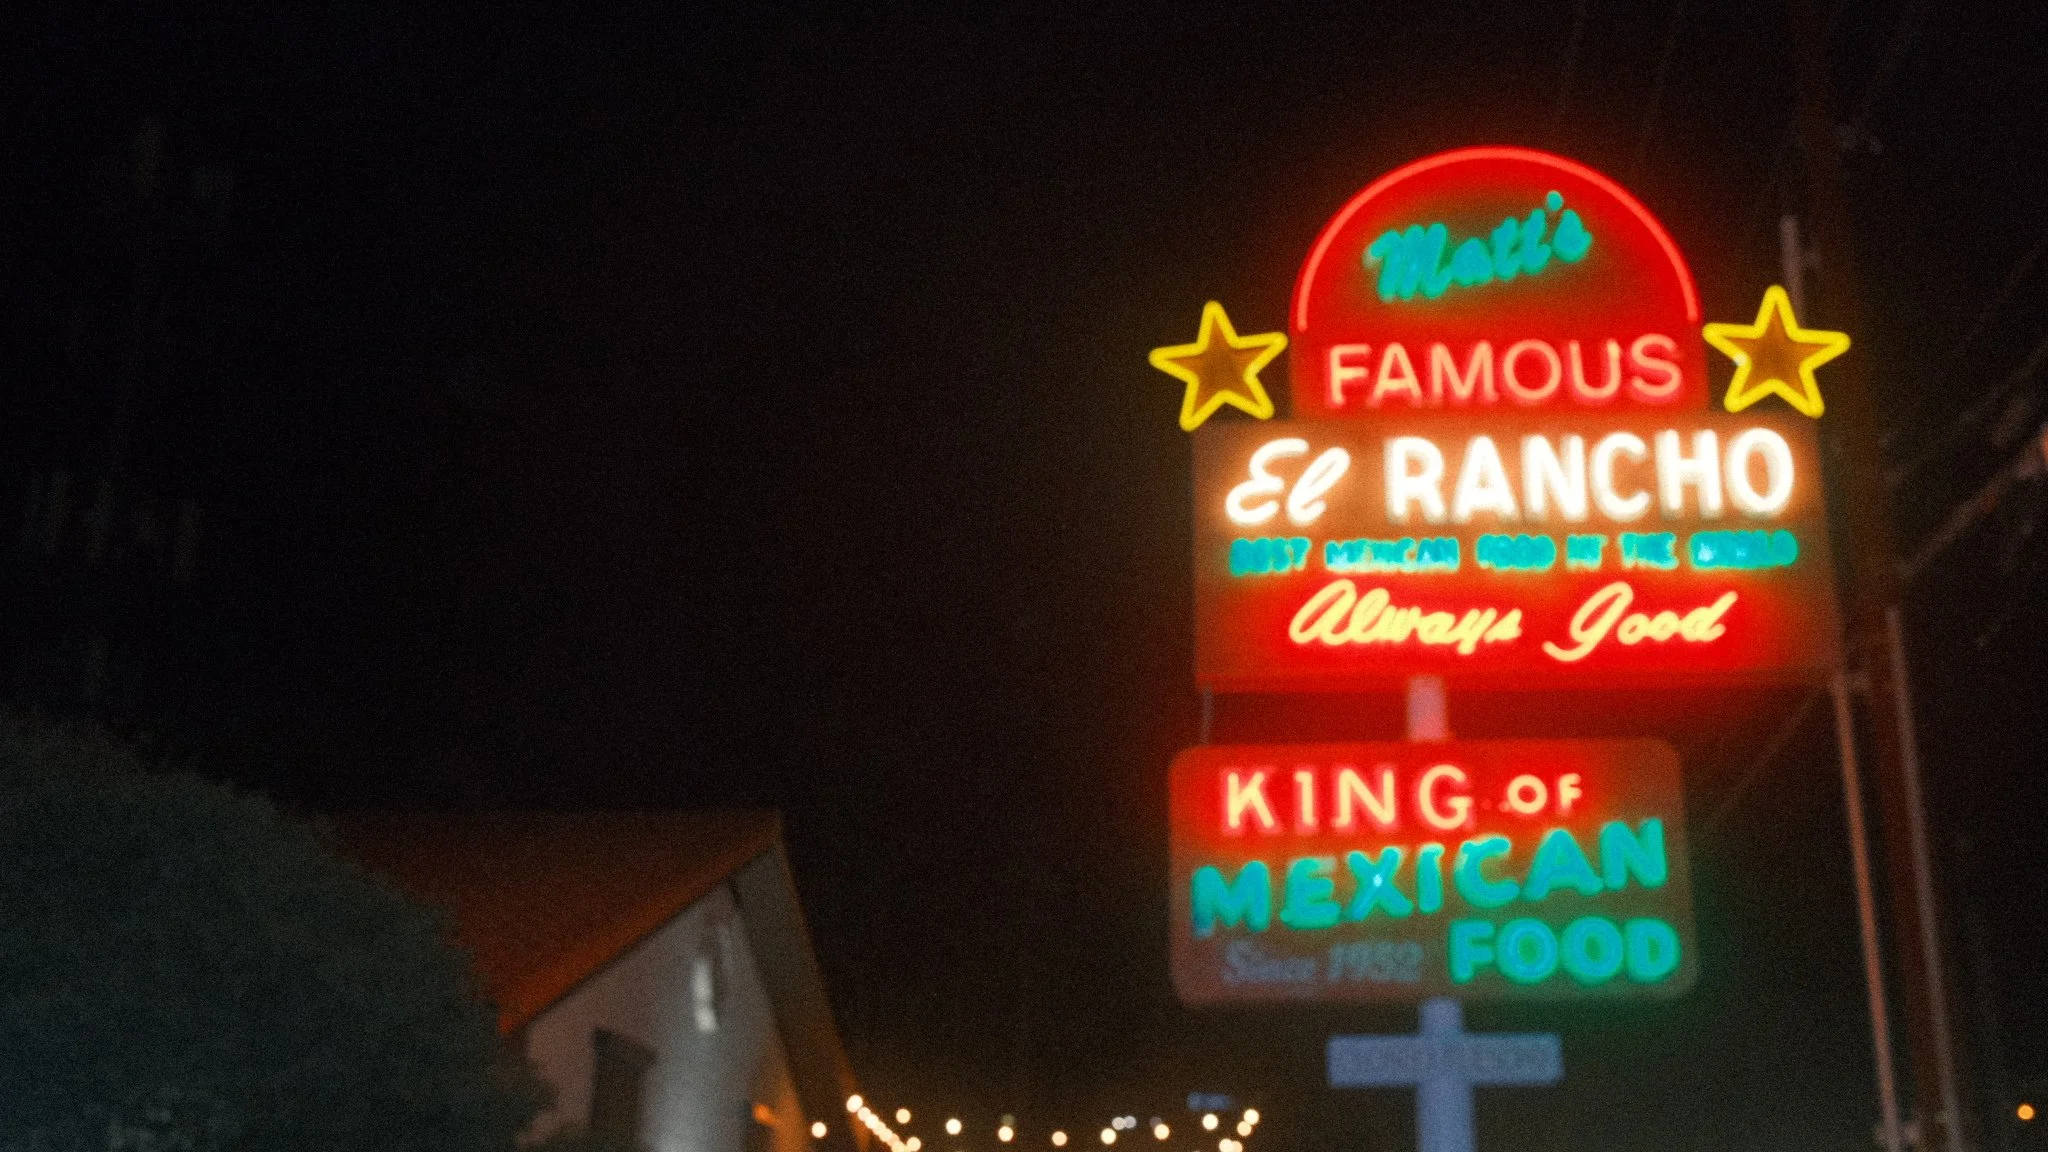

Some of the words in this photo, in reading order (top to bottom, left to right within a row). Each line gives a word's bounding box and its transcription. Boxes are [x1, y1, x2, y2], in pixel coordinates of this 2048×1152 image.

[1365, 190, 1593, 302] Matt's
[1326, 334, 1683, 409] FAMOUS
[1225, 437, 1351, 525] El
[1384, 427, 1796, 524] RANCHO
[1229, 536, 1311, 577] ST
[1323, 536, 1461, 574] MCAN
[1290, 578, 1523, 654] Always
[1543, 580, 1739, 662] Good
[1221, 764, 1475, 836] KING
[1506, 772, 1583, 815] OF
[1191, 817, 1669, 938] MEXICAN
[1327, 940, 1424, 984] 1952
[1448, 915, 1682, 986] FOOD
